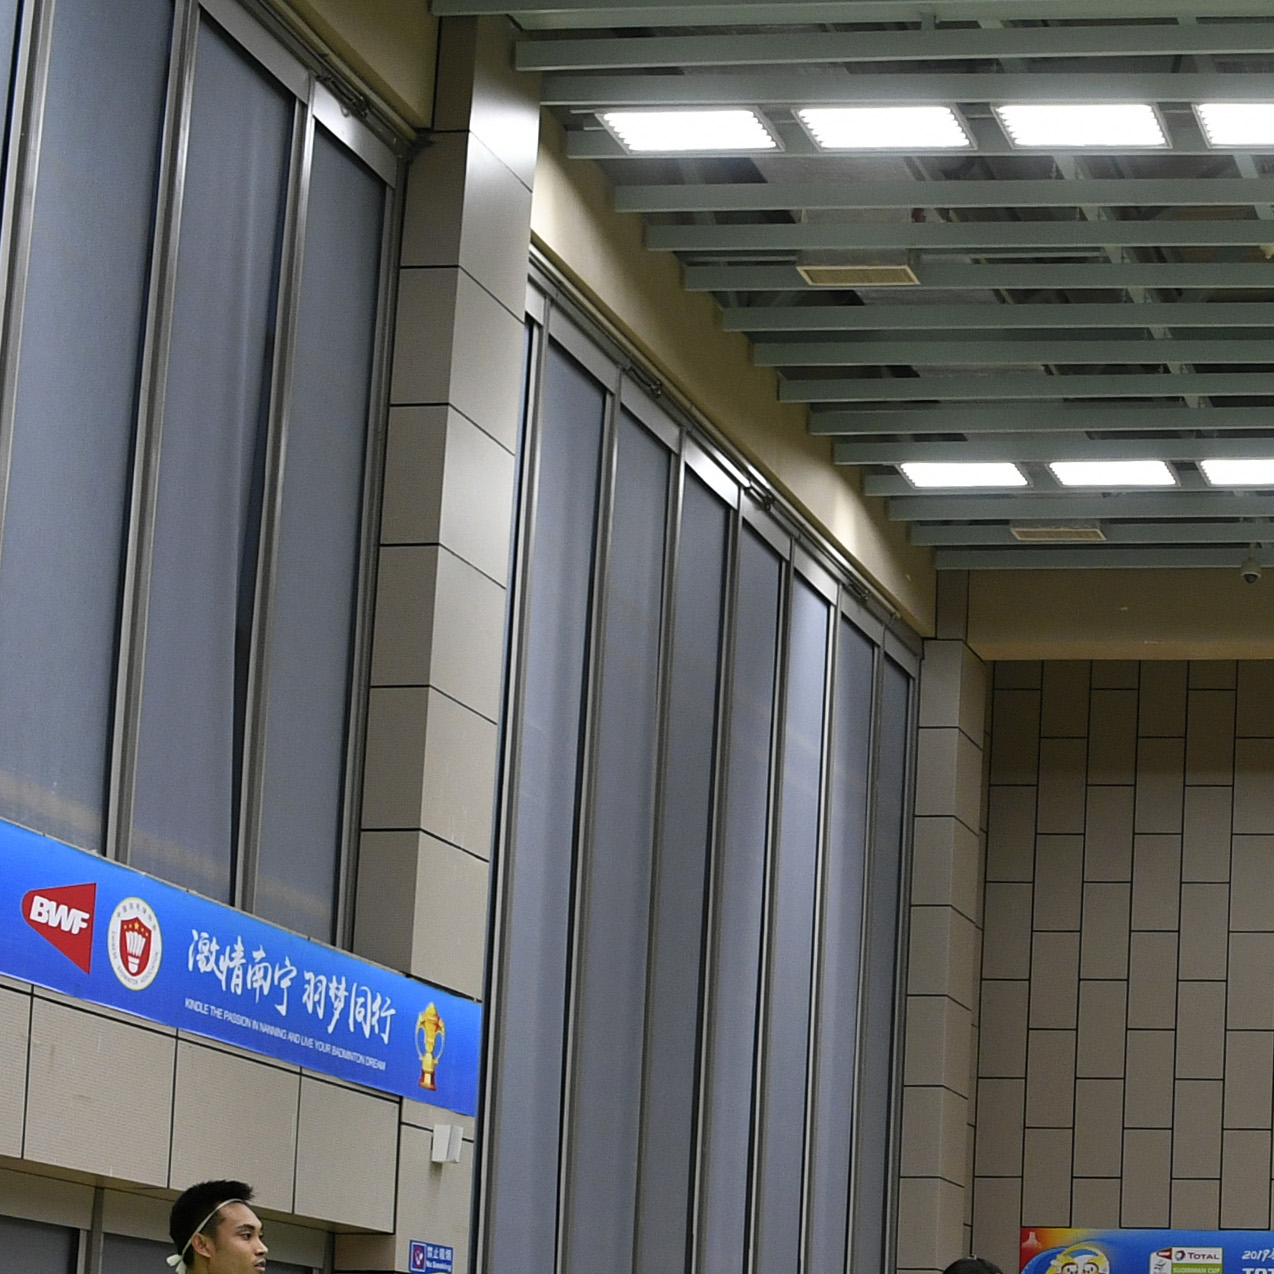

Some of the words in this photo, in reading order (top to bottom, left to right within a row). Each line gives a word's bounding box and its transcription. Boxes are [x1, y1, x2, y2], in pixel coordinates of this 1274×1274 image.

[30, 895, 90, 935] BWF
[187, 929, 298, 1017] 激情南宁
[302, 970, 397, 1045] 羽梦同行
[185, 998, 209, 1015] KINDLE
[210, 1005, 223, 1020] THE
[223, 1010, 252, 1029] PASSION
[252, 1020, 259, 1030] IN
[259, 1022, 287, 1040] NANNING
[287, 1031, 300, 1044] AND
[301, 1036, 314, 1049] LIVE
[314, 1040, 332, 1055] YOUR
[332, 1045, 365, 1065] BADMINTON
[365, 1055, 386, 1071] DREAM
[1188, 1252, 1219, 1260] TOTAL
